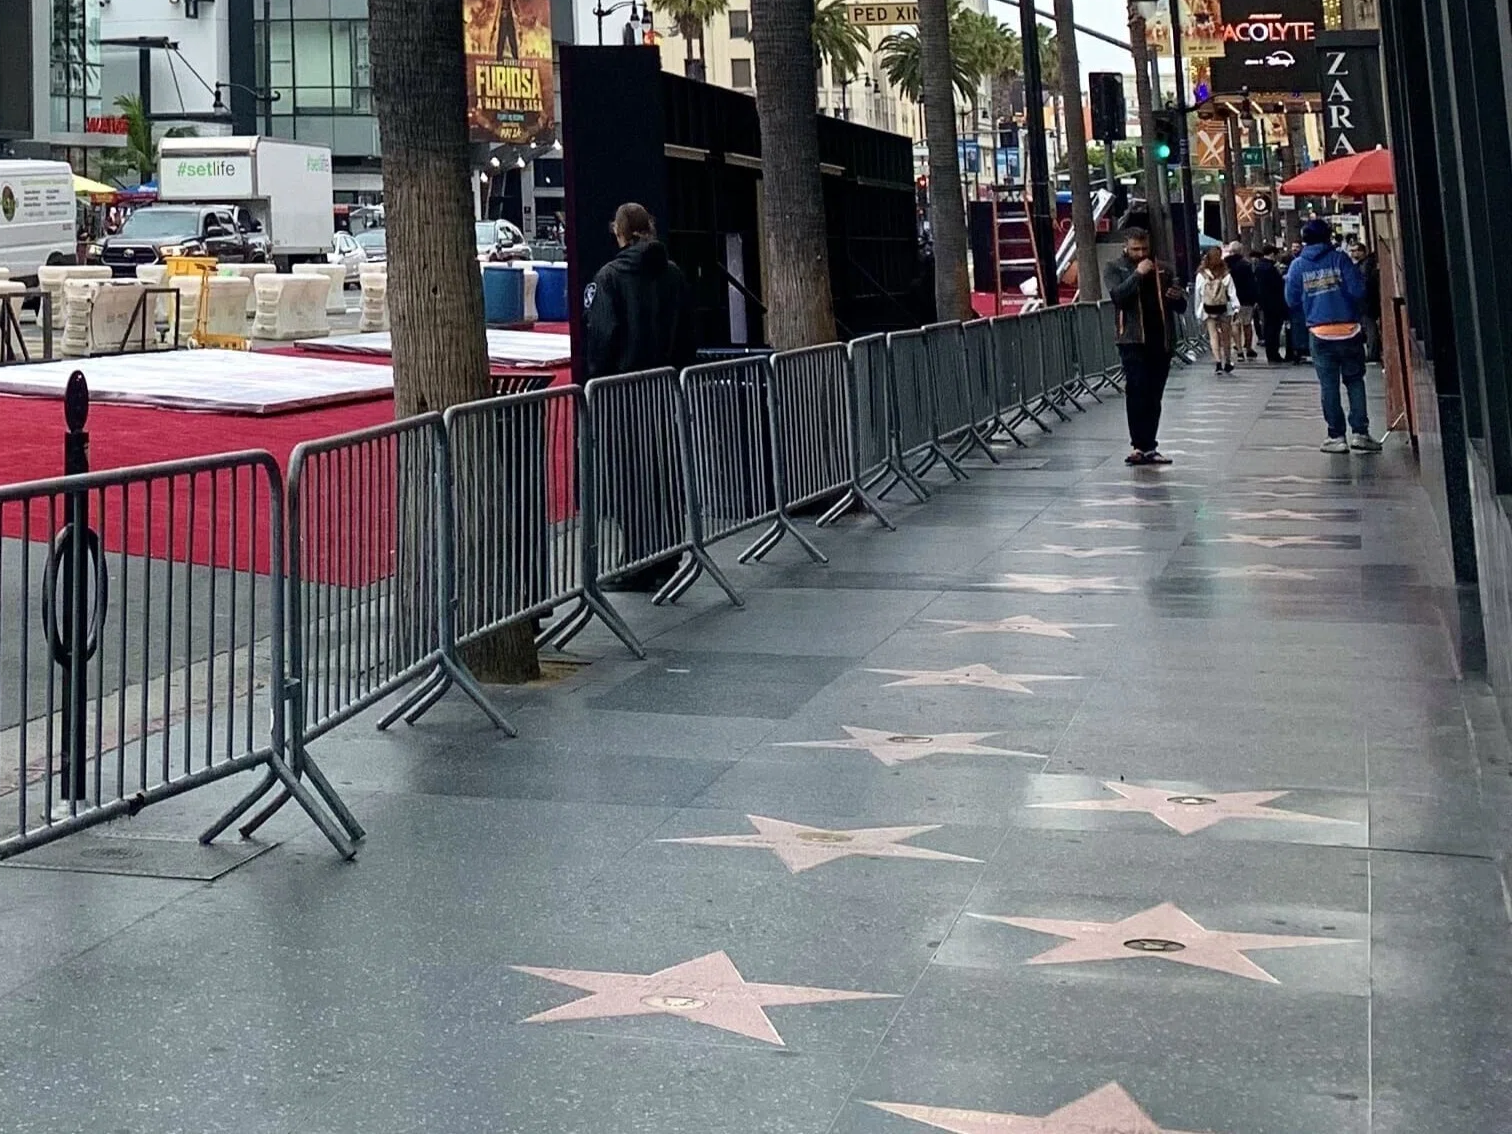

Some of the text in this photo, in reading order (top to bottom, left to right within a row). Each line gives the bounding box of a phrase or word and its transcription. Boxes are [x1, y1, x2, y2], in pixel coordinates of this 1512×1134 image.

[854, 6, 920, 21] PED XIN
[1224, 23, 1316, 41] ACOLYTE
[476, 65, 541, 98] FURIOSA
[485, 98, 501, 110] MAD
[523, 99, 543, 112] SAGA
[1326, 52, 1355, 155] ZARA
[177, 161, 235, 177] #setlife
